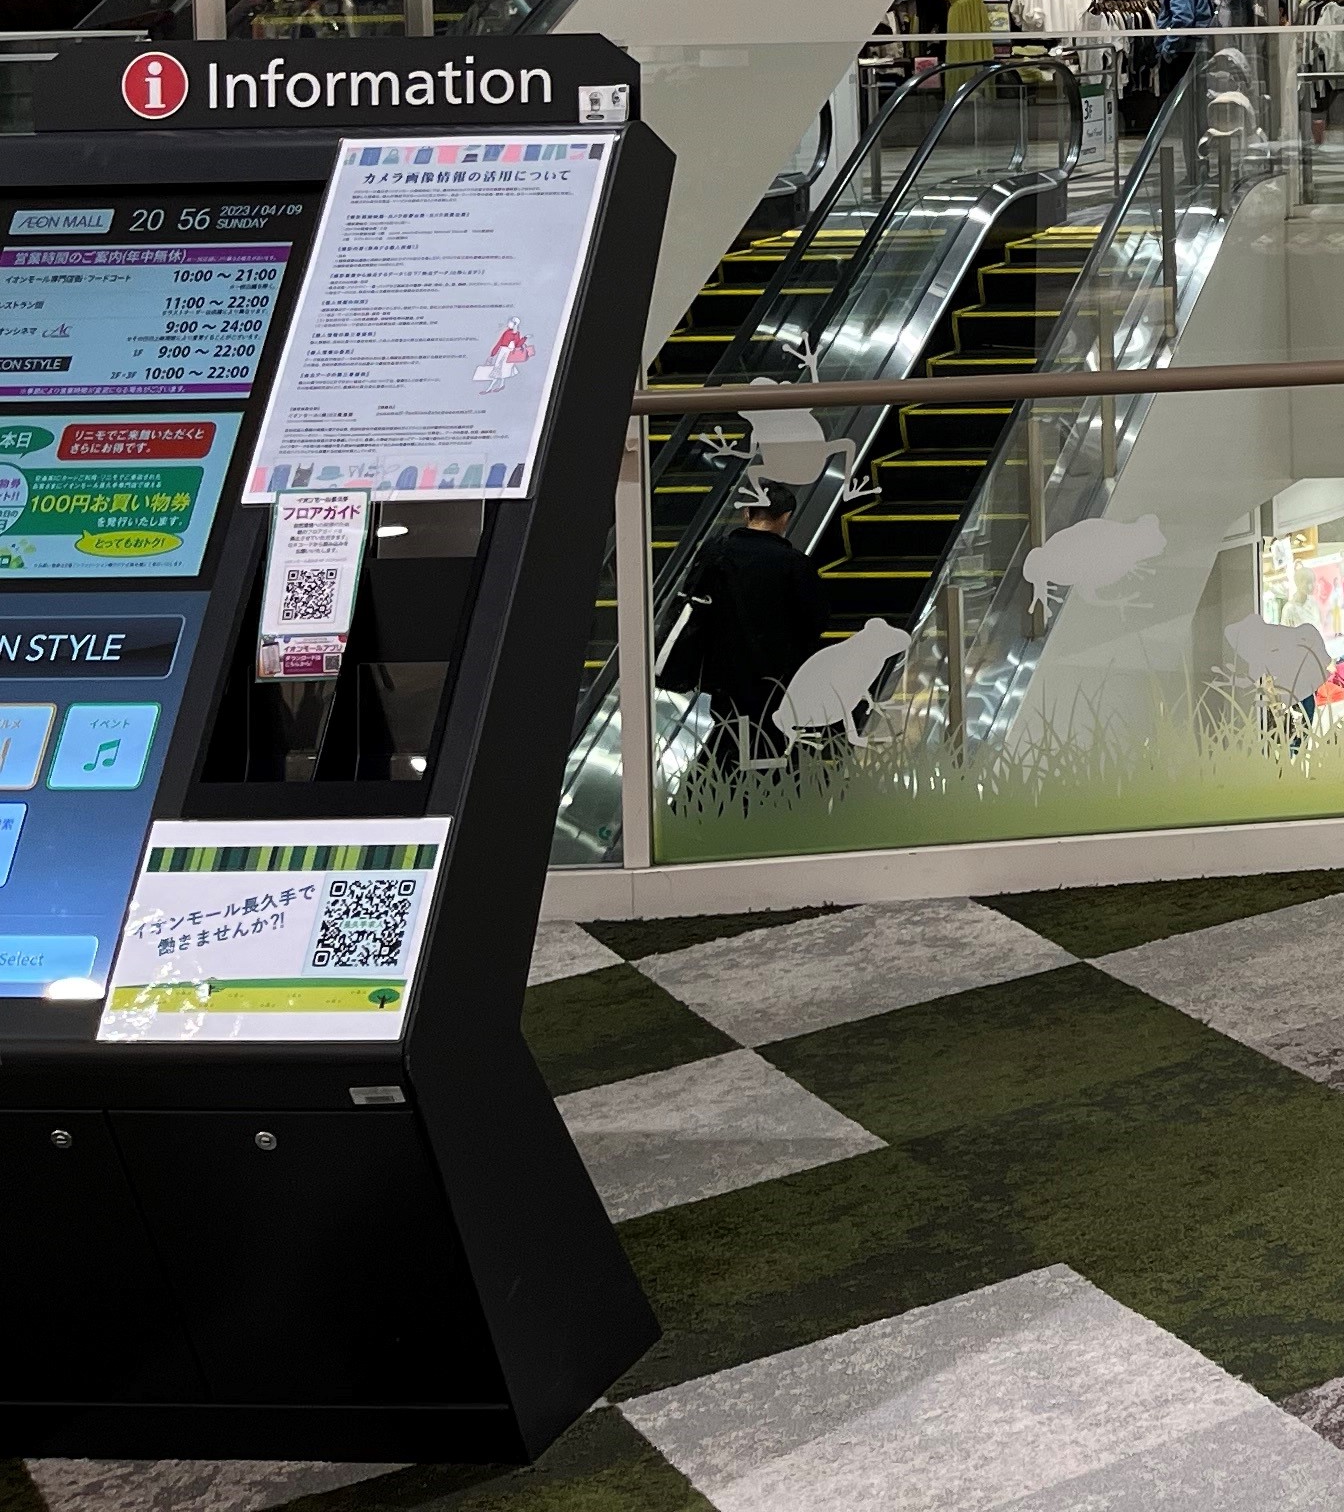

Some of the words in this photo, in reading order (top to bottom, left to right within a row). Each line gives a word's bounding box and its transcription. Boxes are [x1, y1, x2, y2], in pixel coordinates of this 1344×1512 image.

[208, 54, 552, 109] Information
[363, 170, 572, 185] カメラ画像情報の活用について
[62, 213, 105, 228] MALL
[129, 208, 165, 232] 20
[178, 207, 211, 231] 56
[215, 217, 269, 230] SUNDAY
[173, 270, 213, 283] 10:00
[234, 268, 277, 282] 21:00
[165, 297, 205, 310] 11:00
[228, 296, 269, 308] 22:00
[165, 322, 198, 334] 9:00
[222, 320, 264, 333] 24:00
[157, 346, 191, 358] 9:00
[213, 344, 256, 357] 22:00
[23, 358, 62, 370] STYLE
[144, 367, 185, 380] 10:00
[207, 366, 249, 378] 22:00
[30, 492, 191, 514] 100円お買い物券
[282, 505, 362, 521] フロアガイド
[97, 517, 184, 528] を発行いたします。
[24, 633, 127, 663] STYLE
[89, 718, 131, 729] イベント
[134, 883, 317, 940] イオンモール長久手で
